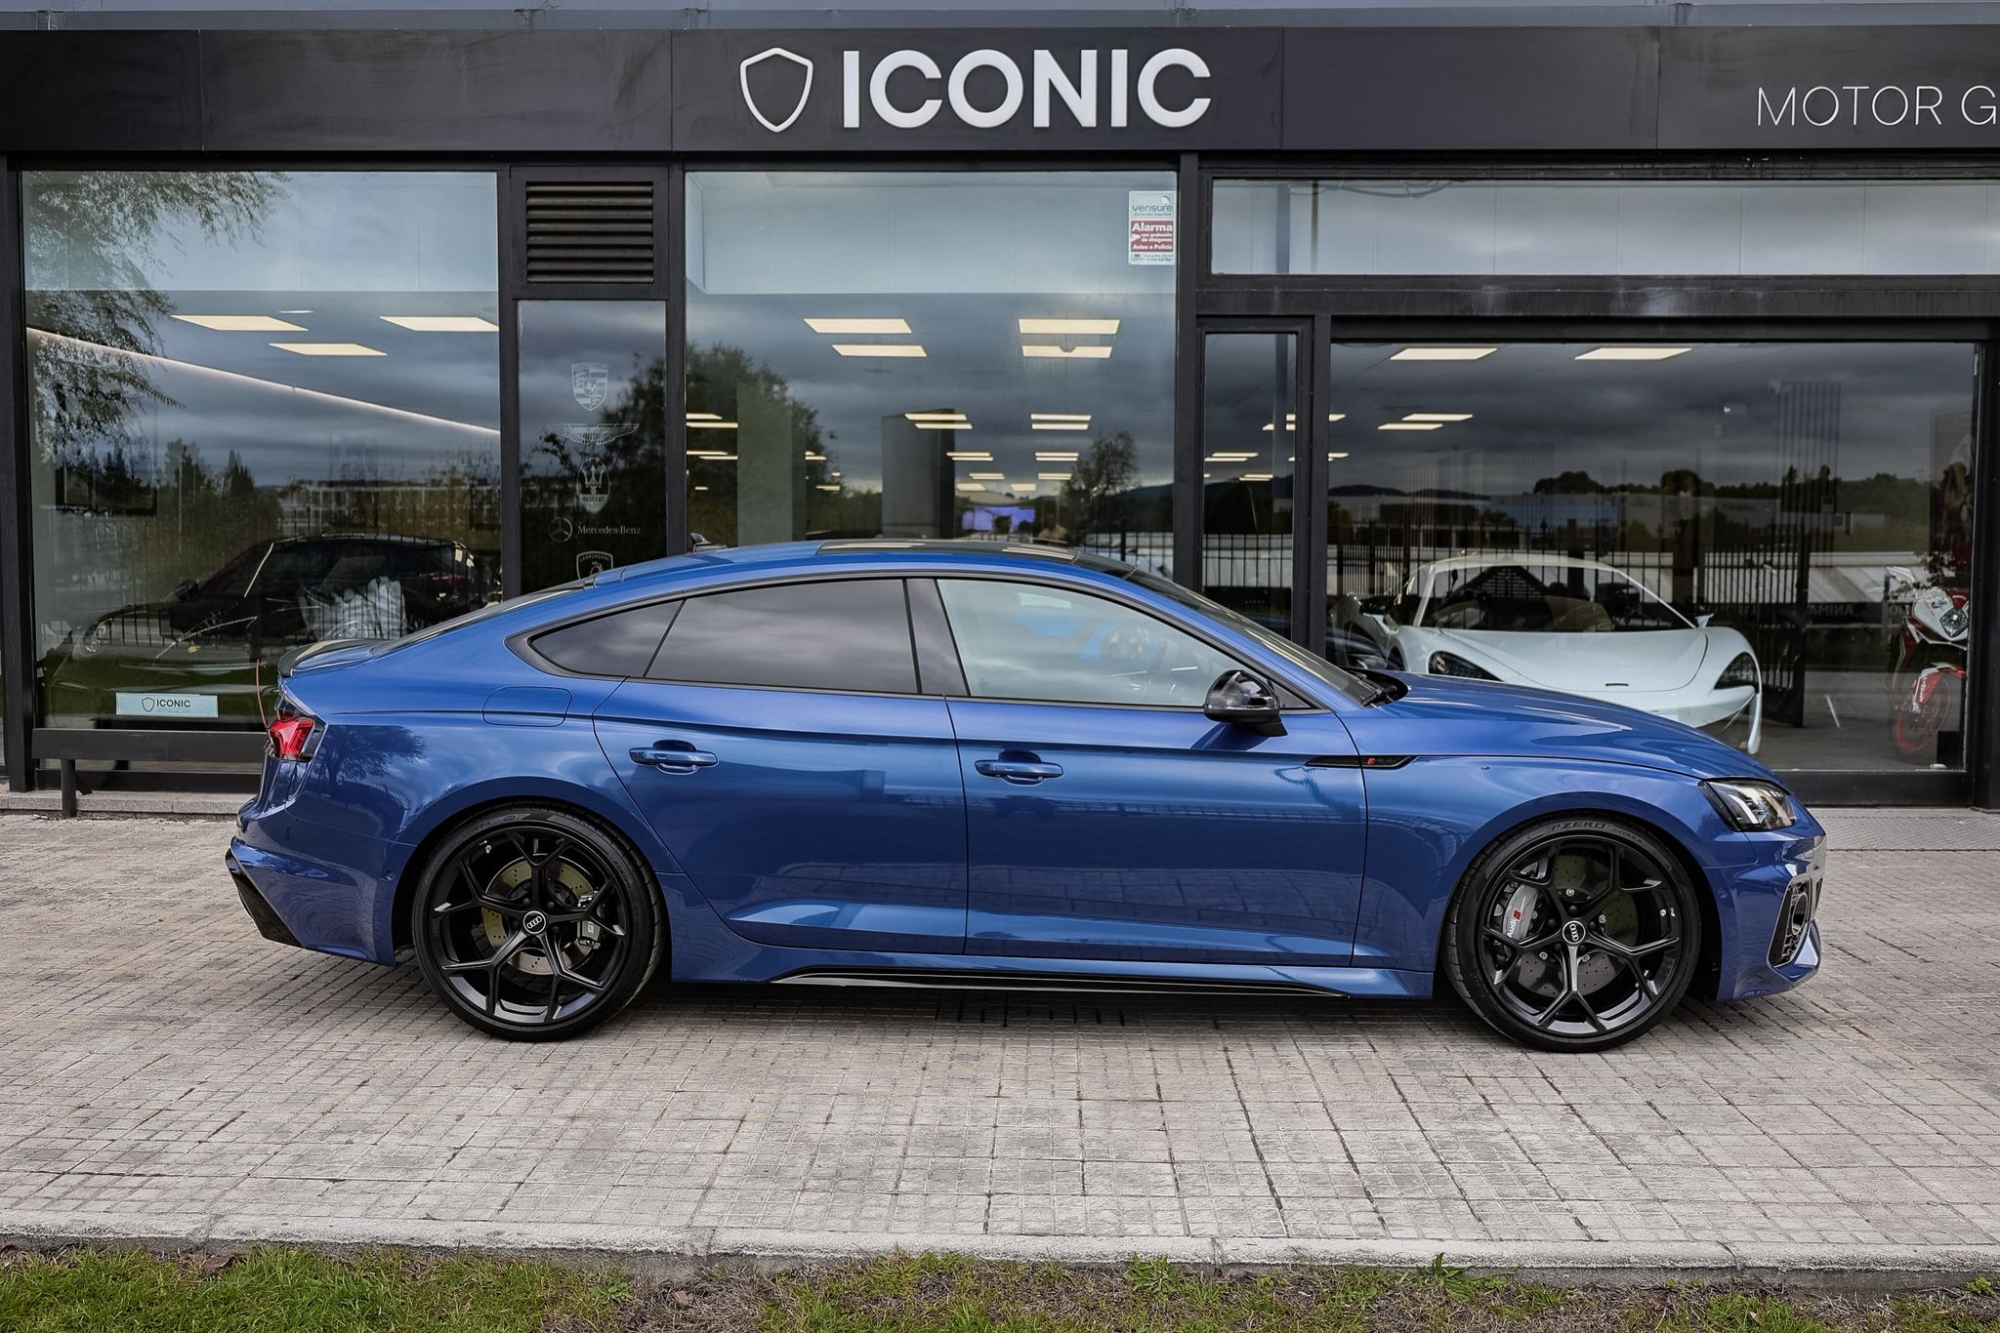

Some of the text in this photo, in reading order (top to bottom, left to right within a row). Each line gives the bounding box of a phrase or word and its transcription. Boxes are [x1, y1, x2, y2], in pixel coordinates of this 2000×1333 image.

[843, 48, 1212, 129] ICONIC
[1757, 84, 1997, 126] MOTOR G
[1132, 222, 1173, 232] Alarma
[577, 525, 641, 535] Mercedes-Benz
[156, 699, 191, 708] ICONIC
[1507, 918, 1517, 938] Audi
